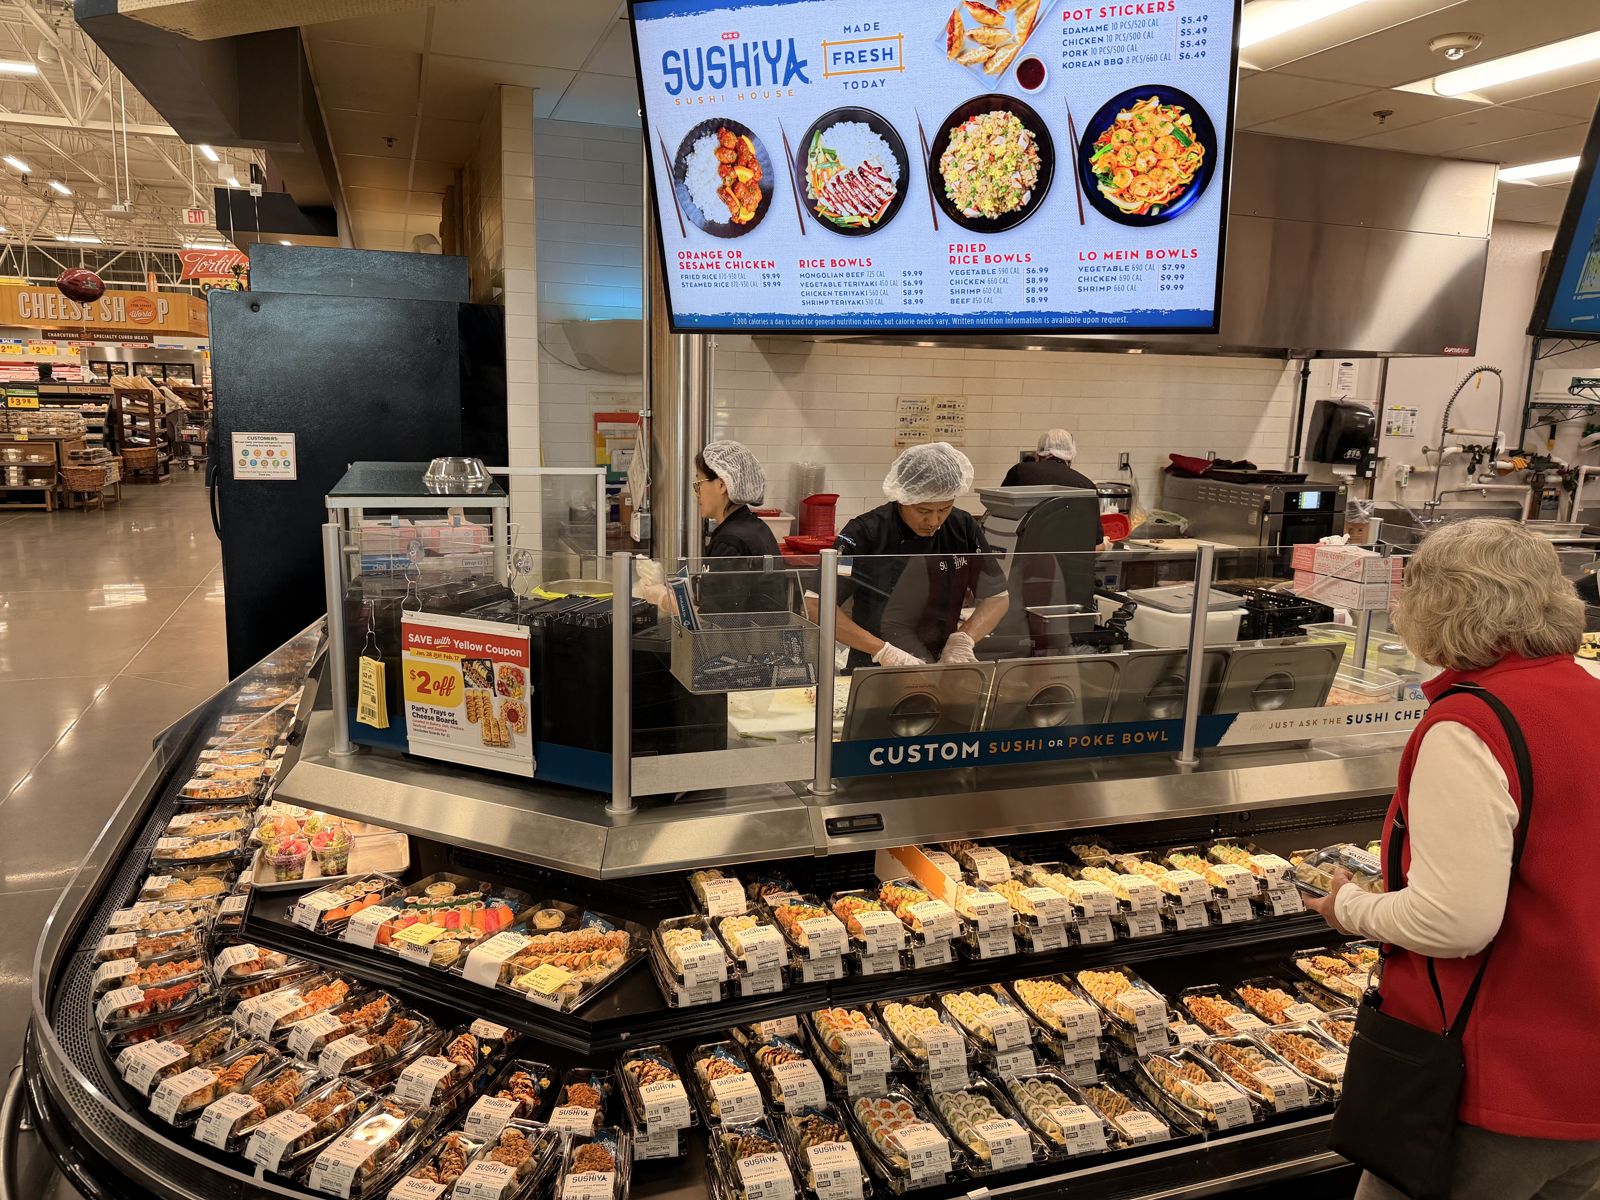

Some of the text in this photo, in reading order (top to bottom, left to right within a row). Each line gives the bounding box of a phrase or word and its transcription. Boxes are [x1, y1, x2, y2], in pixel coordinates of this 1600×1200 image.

[1063, 1, 1175, 22] POT STICKERS
[843, 22, 880, 34] MADE
[1062, 24, 1109, 35] EDAMAME
[1148, 18, 1159, 27] CAL
[1181, 14, 1208, 24] $5.49
[1062, 36, 1104, 46] CHICKEN
[1143, 31, 1154, 39] CAL
[1180, 26, 1207, 37] $5.49
[1062, 49, 1088, 58] PORK
[1126, 44, 1138, 52] CAL
[1180, 38, 1207, 49] $5.49
[833, 47, 893, 65] FRESH
[1062, 60, 1100, 69] KOREAN
[1104, 57, 1124, 66] BBQ
[1160, 52, 1171, 61] CAL
[1179, 50, 1206, 61] $6.49
[843, 79, 886, 90] TODAY
[675, 89, 794, 106] SUSHI HOUSE
[187, 210, 205, 224] EXIT
[678, 250, 742, 259] ORANGE OR
[949, 243, 986, 253] FRIED
[1079, 248, 1198, 261] LO MEIN BOWLS
[679, 260, 775, 270] SESAME CHICKEN
[799, 258, 872, 269] RICE BOWLS
[949, 253, 1031, 264] RICE BOWLS
[949, 268, 996, 276] VEGETABLE
[844, 280, 878, 288] TERIYAKI
[1078, 284, 1184, 293] SHRIMP $9.99
[1026, 296, 1048, 304] $8.99
[775, 318, 784, 326] day
[815, 318, 835, 326] general
[936, 319, 950, 327] vary.
[952, 317, 974, 325] Written
[975, 317, 1003, 325] nutrition
[1044, 316, 1049, 324] is
[1051, 316, 1080, 324] available
[1083, 317, 1099, 325] upon
[1102, 316, 1128, 324] request.
[408, 634, 522, 658] SAVE with Yellow Coupon
[409, 669, 455, 697] $2 off
[411, 704, 428, 715] Party
[430, 708, 447, 717] Trays
[412, 711, 458, 725] Cheese Boards
[1268, 720, 1294, 730] JUST
[1298, 719, 1318, 727] ASK
[1322, 717, 1342, 726] THE
[1346, 712, 1389, 725] SUSHI
[869, 730, 1169, 766] CUSTOM SUSHI OR POKE BOWL
